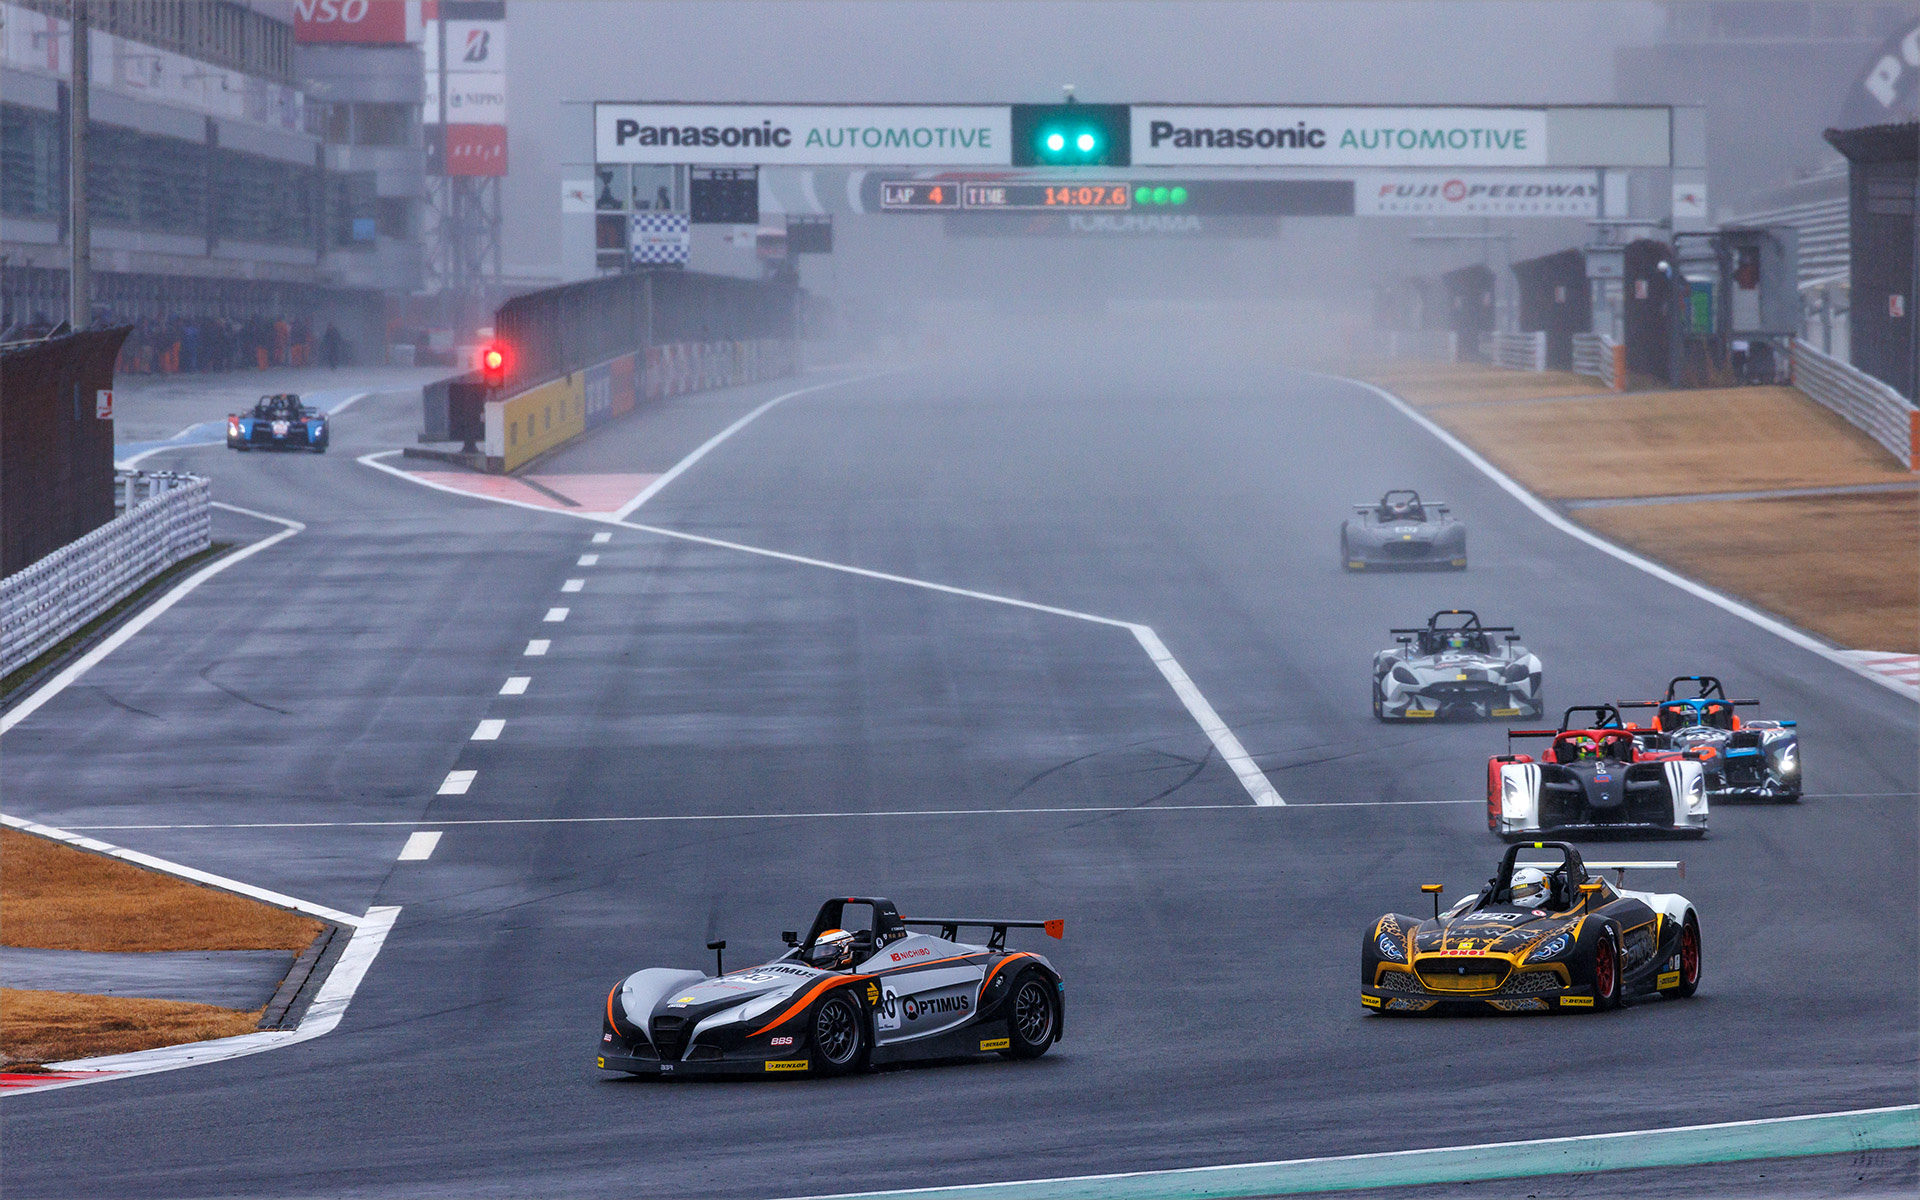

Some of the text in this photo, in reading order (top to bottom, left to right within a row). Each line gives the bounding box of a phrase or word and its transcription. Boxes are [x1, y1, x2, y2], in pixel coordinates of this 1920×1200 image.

[616, 119, 992, 149] Panasonic AUTOMOTIVE
[1149, 120, 1528, 150] Panasonic AUTOMOTIVE
[885, 186, 943, 204] LAP 4
[968, 186, 1126, 205] TIME 14:07.6
[1378, 183, 1440, 198] FUJI
[900, 947, 931, 960] NICHIBO
[770, 1037, 794, 1046] BBS
[985, 1040, 1008, 1048] DUNLOP
